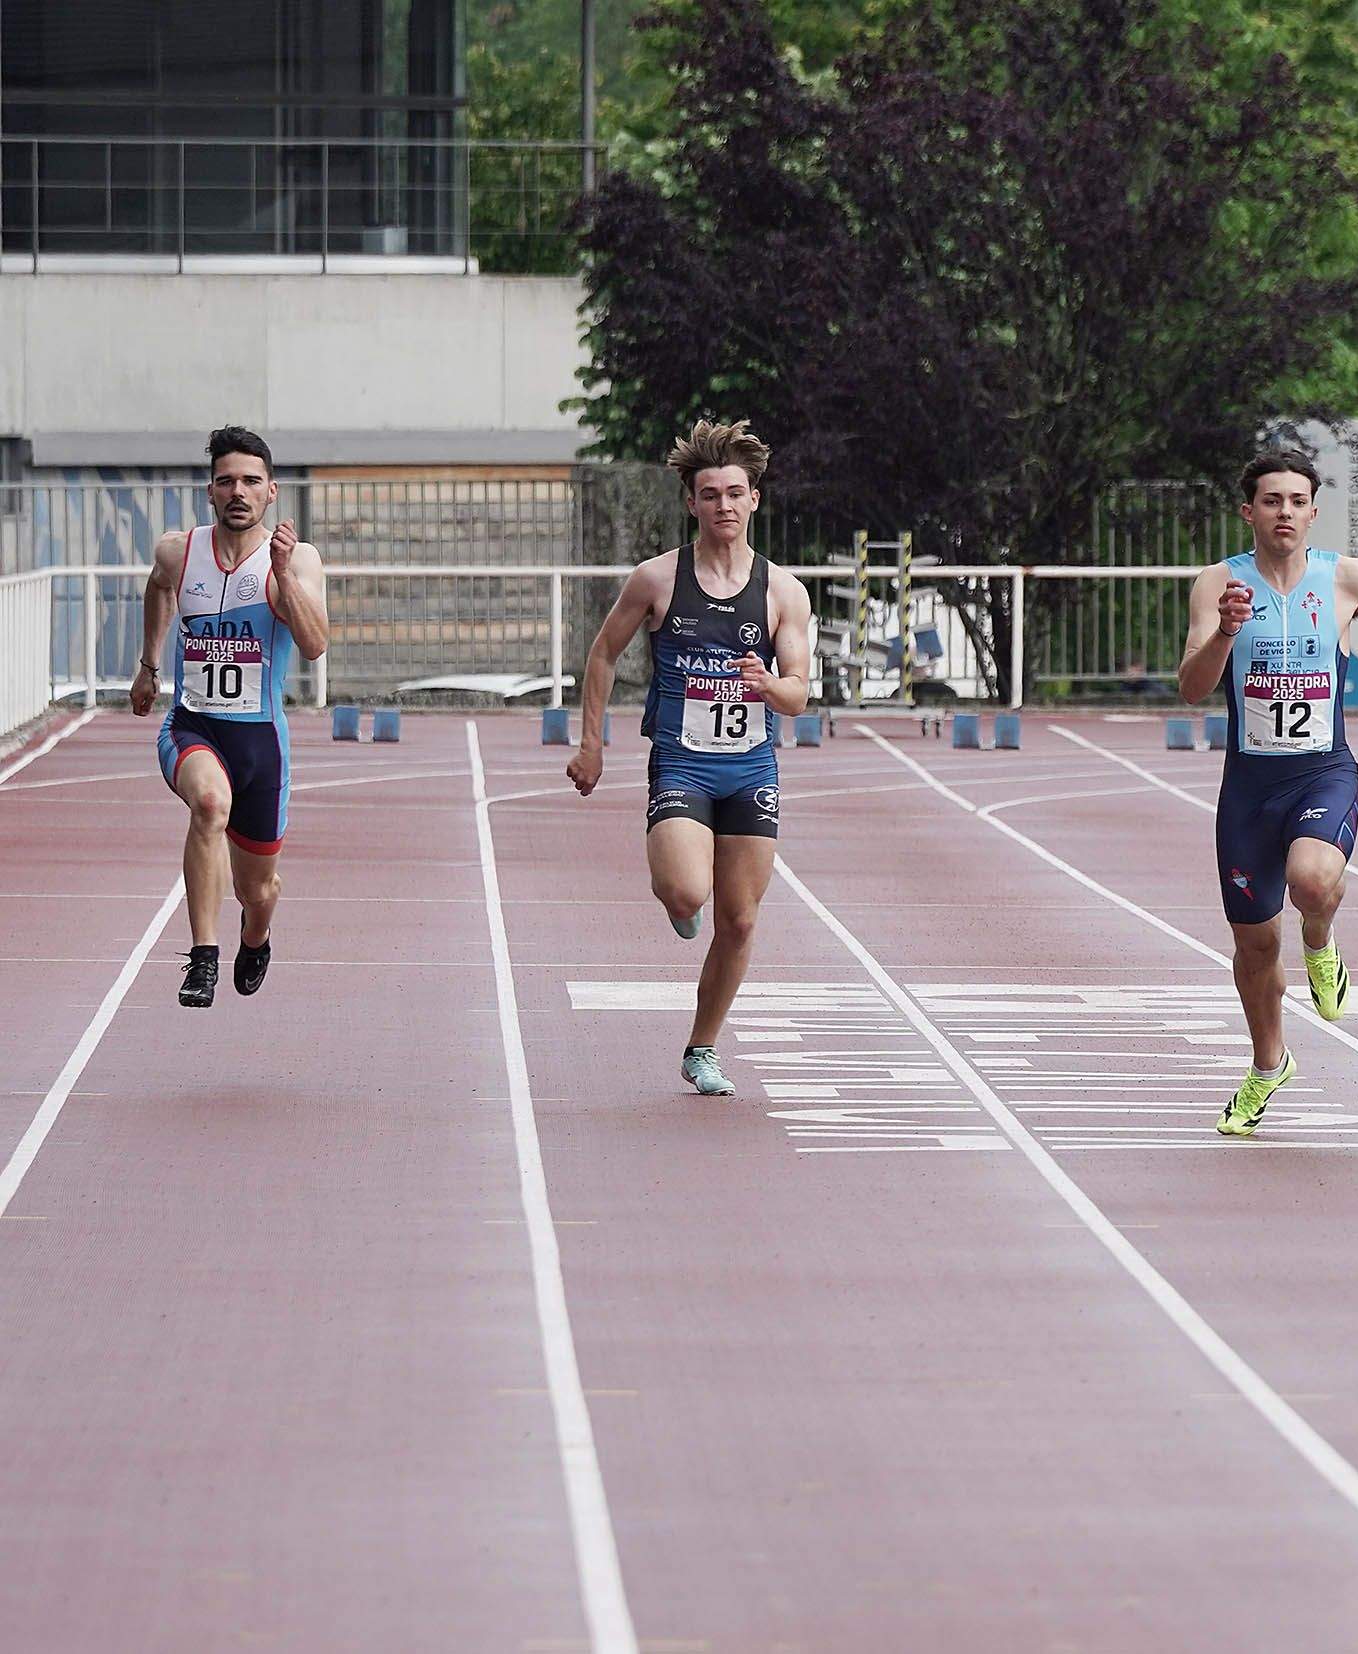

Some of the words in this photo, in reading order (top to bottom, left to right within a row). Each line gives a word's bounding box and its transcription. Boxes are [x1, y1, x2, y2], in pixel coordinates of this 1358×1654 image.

[201, 620, 255, 638] ADA
[185, 638, 261, 653] PONTEVEDRA
[206, 651, 234, 662] 2025
[201, 663, 243, 699] 10
[688, 676, 751, 692] PONTEVE
[1246, 675, 1329, 689] PONTEVEDRA
[713, 690, 743, 702] 2025
[1272, 688, 1304, 700] 2025
[709, 703, 748, 739] 13
[1269, 702, 1312, 738] 12
